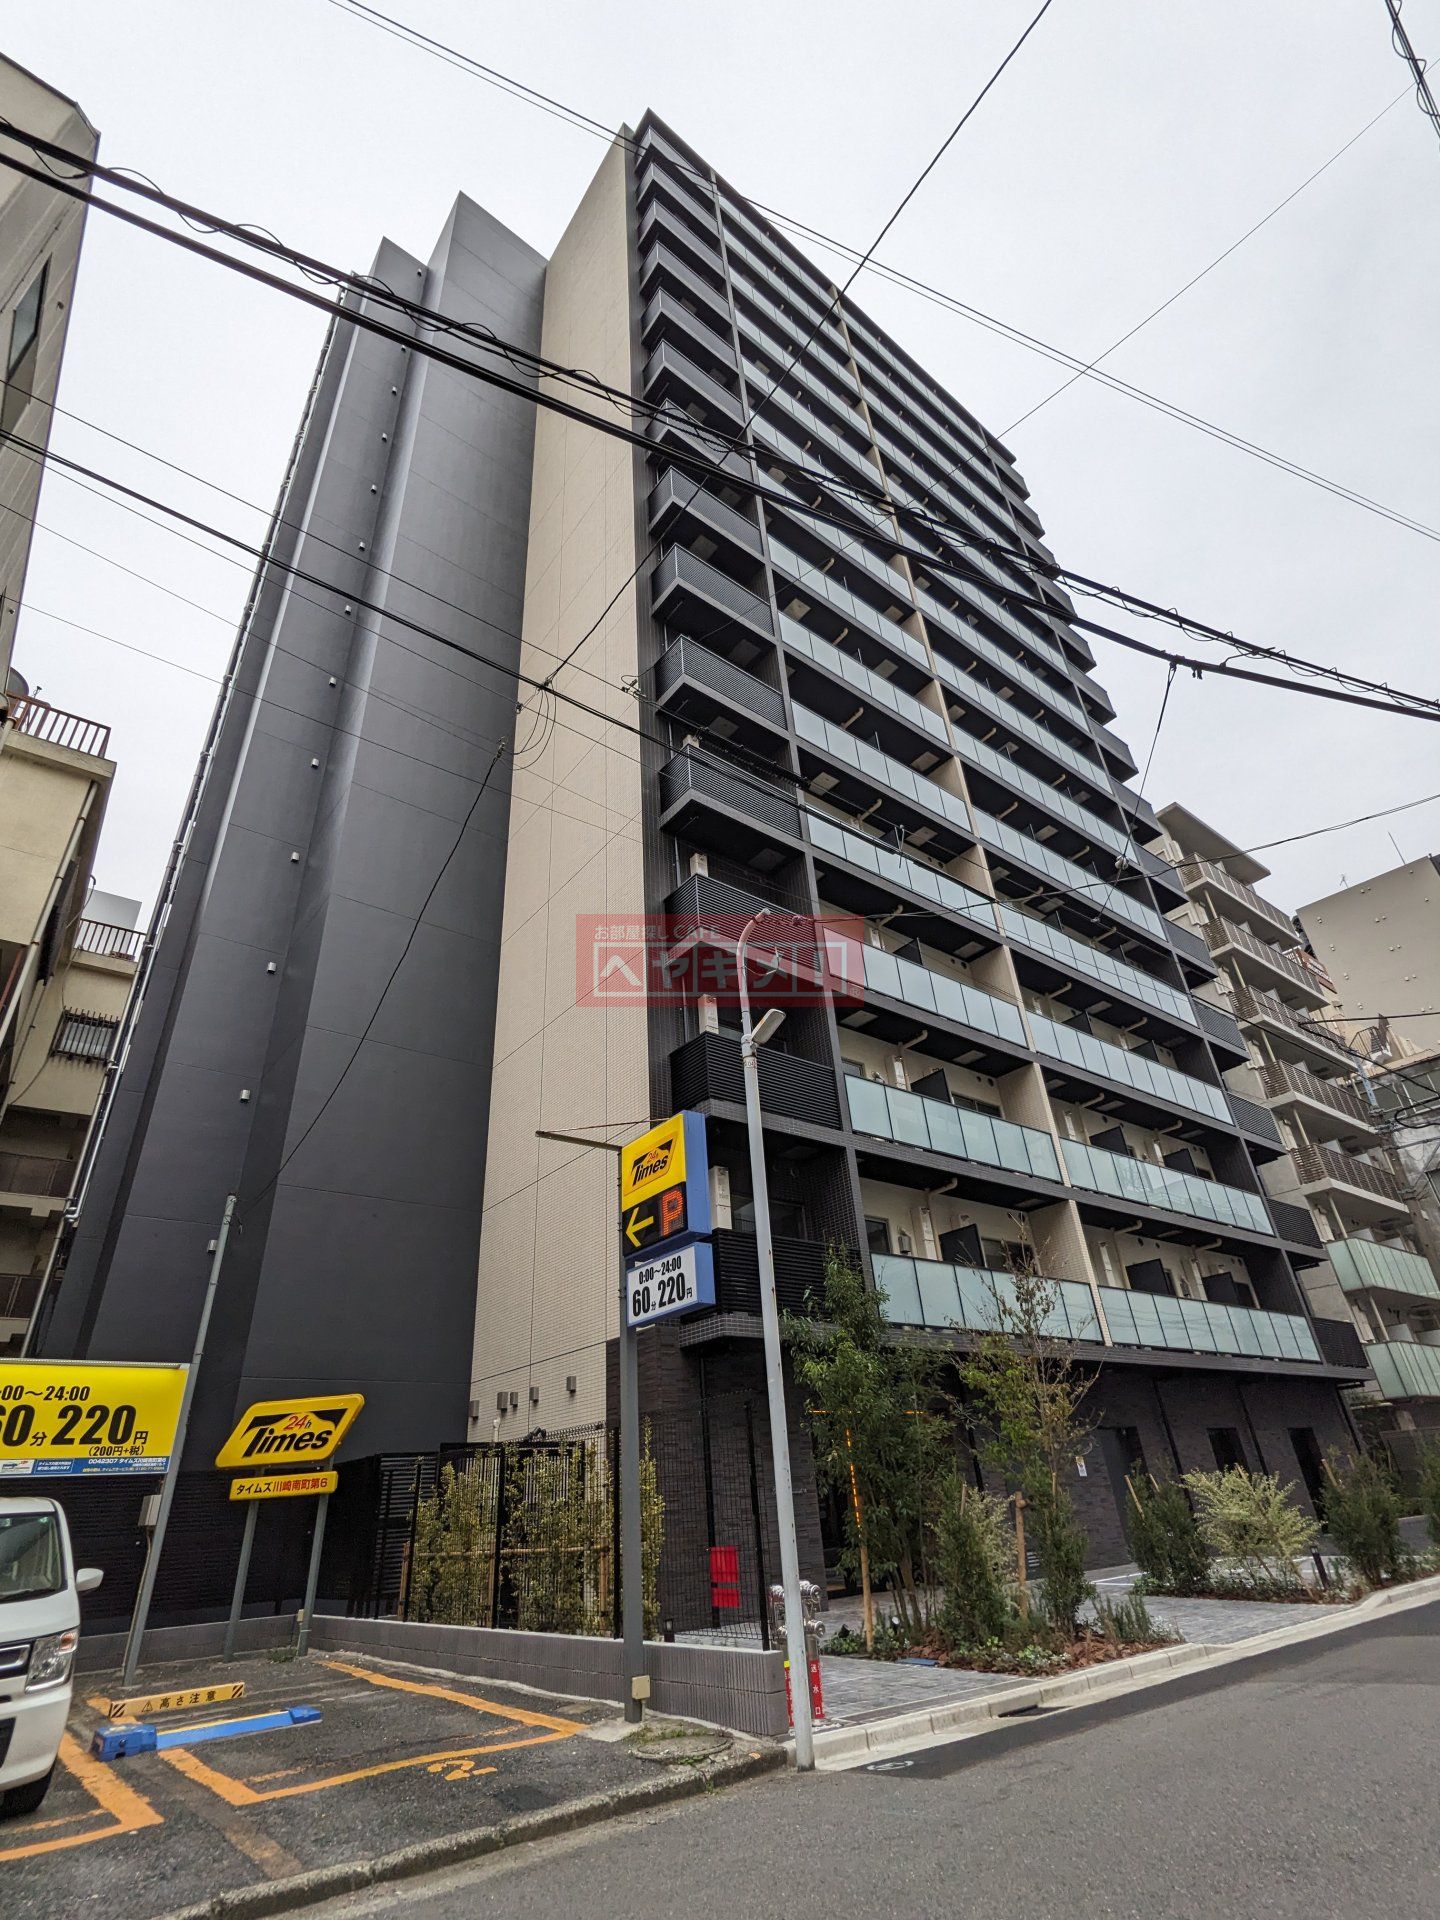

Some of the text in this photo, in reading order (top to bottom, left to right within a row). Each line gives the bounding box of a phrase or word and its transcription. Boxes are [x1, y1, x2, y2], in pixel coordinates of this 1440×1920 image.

[632, 1155, 669, 1186] Times
[662, 1190, 683, 1236] P
[242, 1427, 333, 1458] Times
[236, 1477, 328, 1495] タイムズ川崎南町第6
[159, 1690, 216, 1709] 高さ注意
